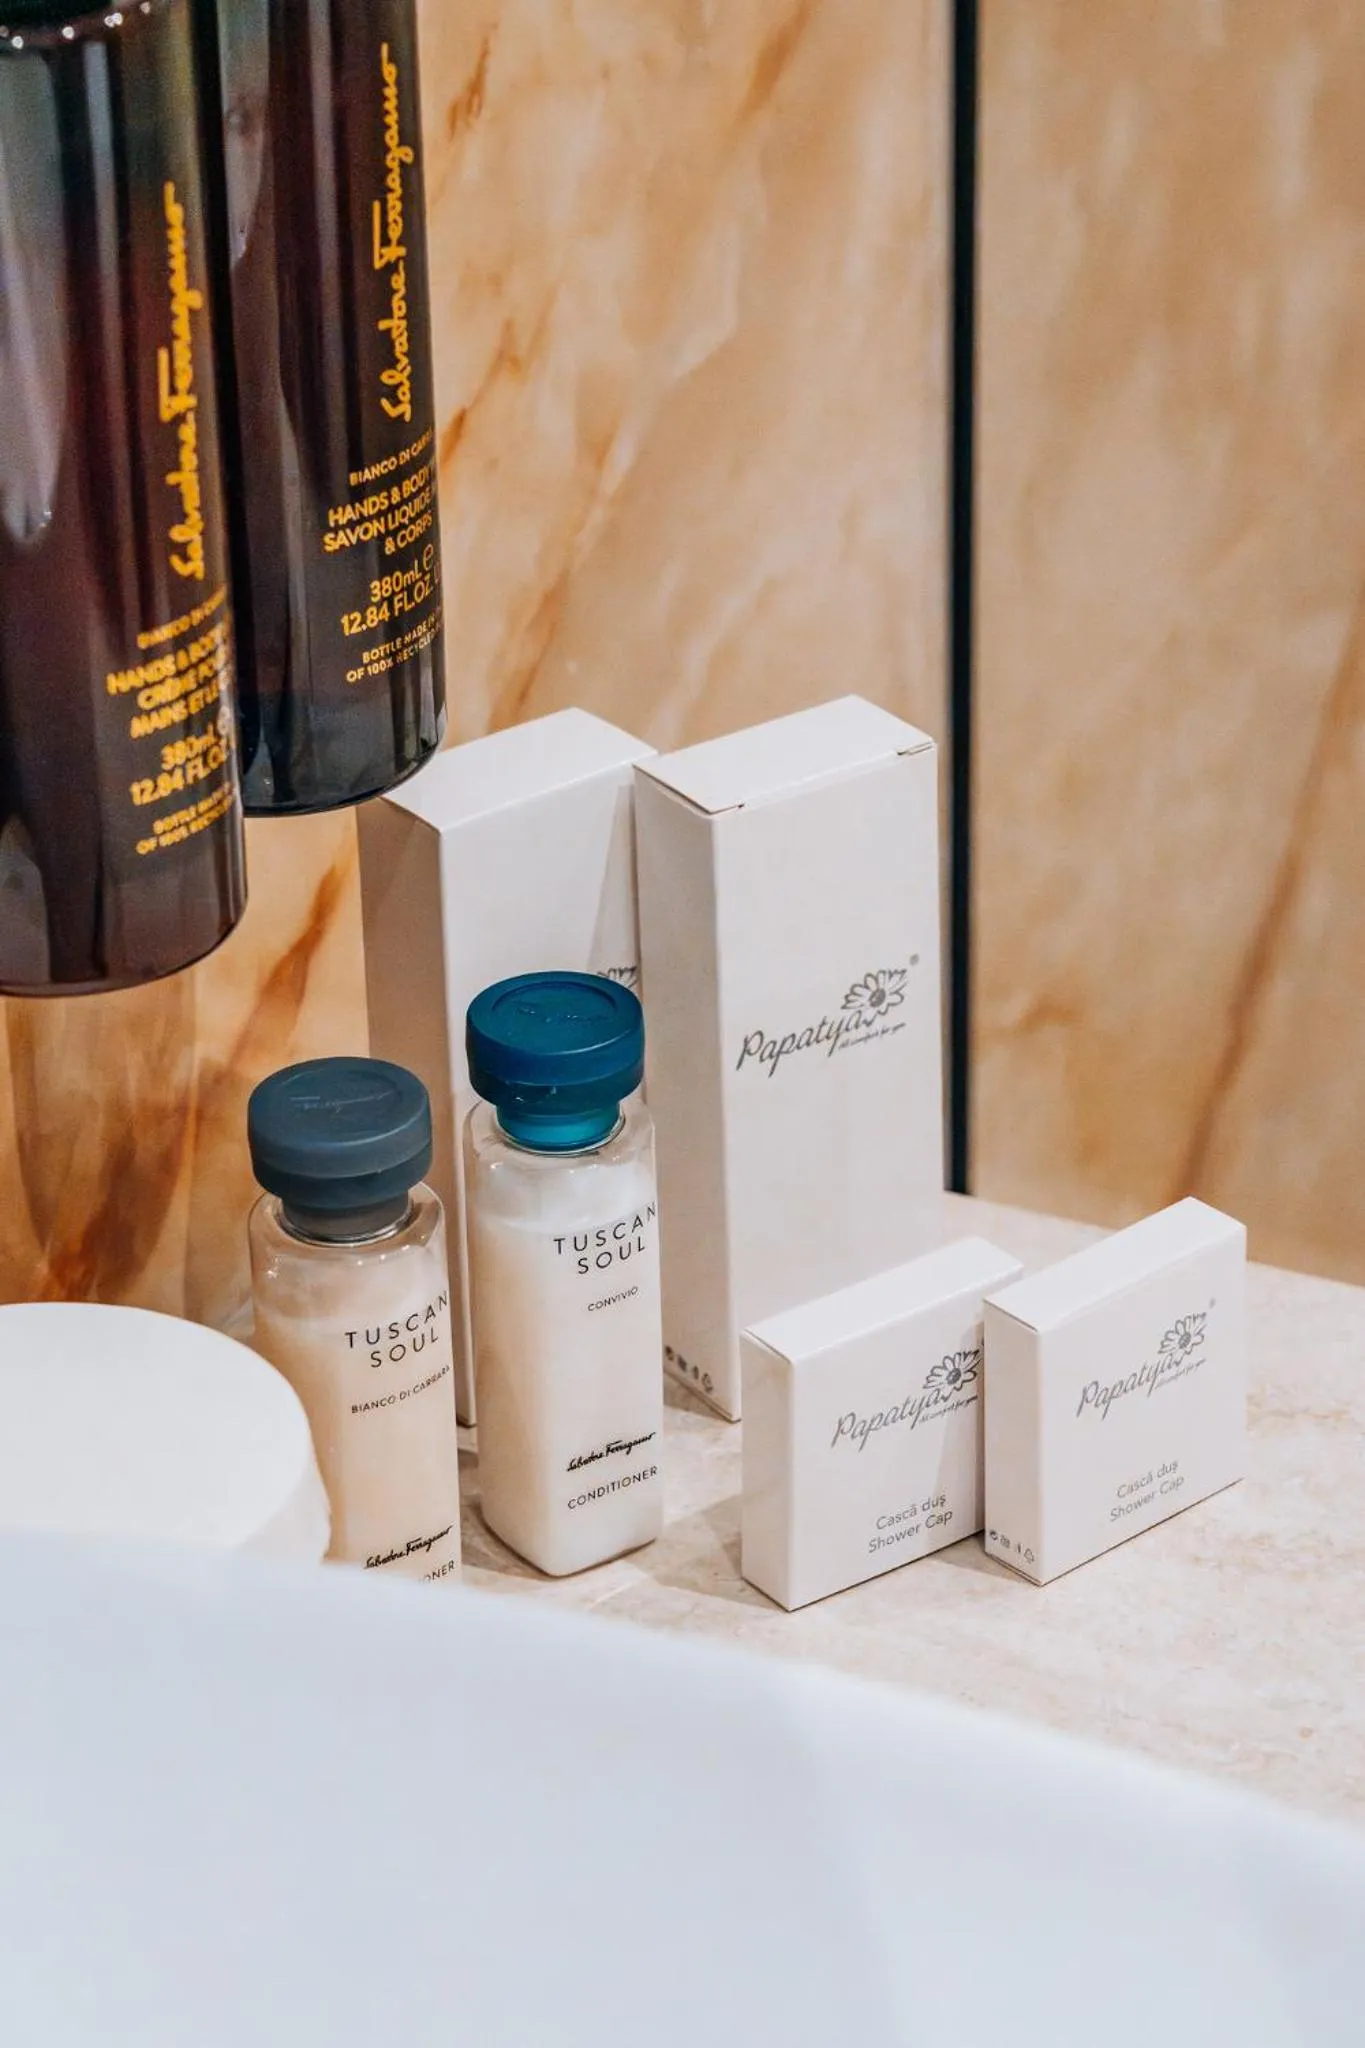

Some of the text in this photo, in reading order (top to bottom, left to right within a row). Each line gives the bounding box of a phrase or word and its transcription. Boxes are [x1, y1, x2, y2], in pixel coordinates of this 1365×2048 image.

[378, 271, 413, 422] Salvatore
[349, 456, 398, 486] BIANCO
[399, 448, 411, 465] DI
[327, 491, 389, 528] HANDS
[391, 486, 401, 505] &
[323, 516, 386, 553] SAVON
[385, 509, 433, 555] & CORPS
[370, 559, 423, 603] 380mL
[341, 600, 391, 636] 12.84
[362, 637, 403, 664] BOTTLE
[346, 667, 365, 683] OF
[735, 1009, 864, 1079] Papatya
[553, 1201, 657, 1255] TUSCAN
[577, 1235, 645, 1275] SOUL
[345, 1290, 449, 1349] TUSCAN
[587, 1286, 639, 1312] CONVIVIO
[370, 1327, 439, 1368] SOUL
[351, 1394, 396, 1414] BIANCO
[399, 1390, 411, 1401] DI
[1076, 1353, 1179, 1421] Papatya
[831, 1388, 941, 1452] Papatya
[567, 1465, 658, 1510] CONDITIONER
[1110, 1474, 1185, 1522] Shower Cap
[868, 1509, 953, 1554] Shower Cap
